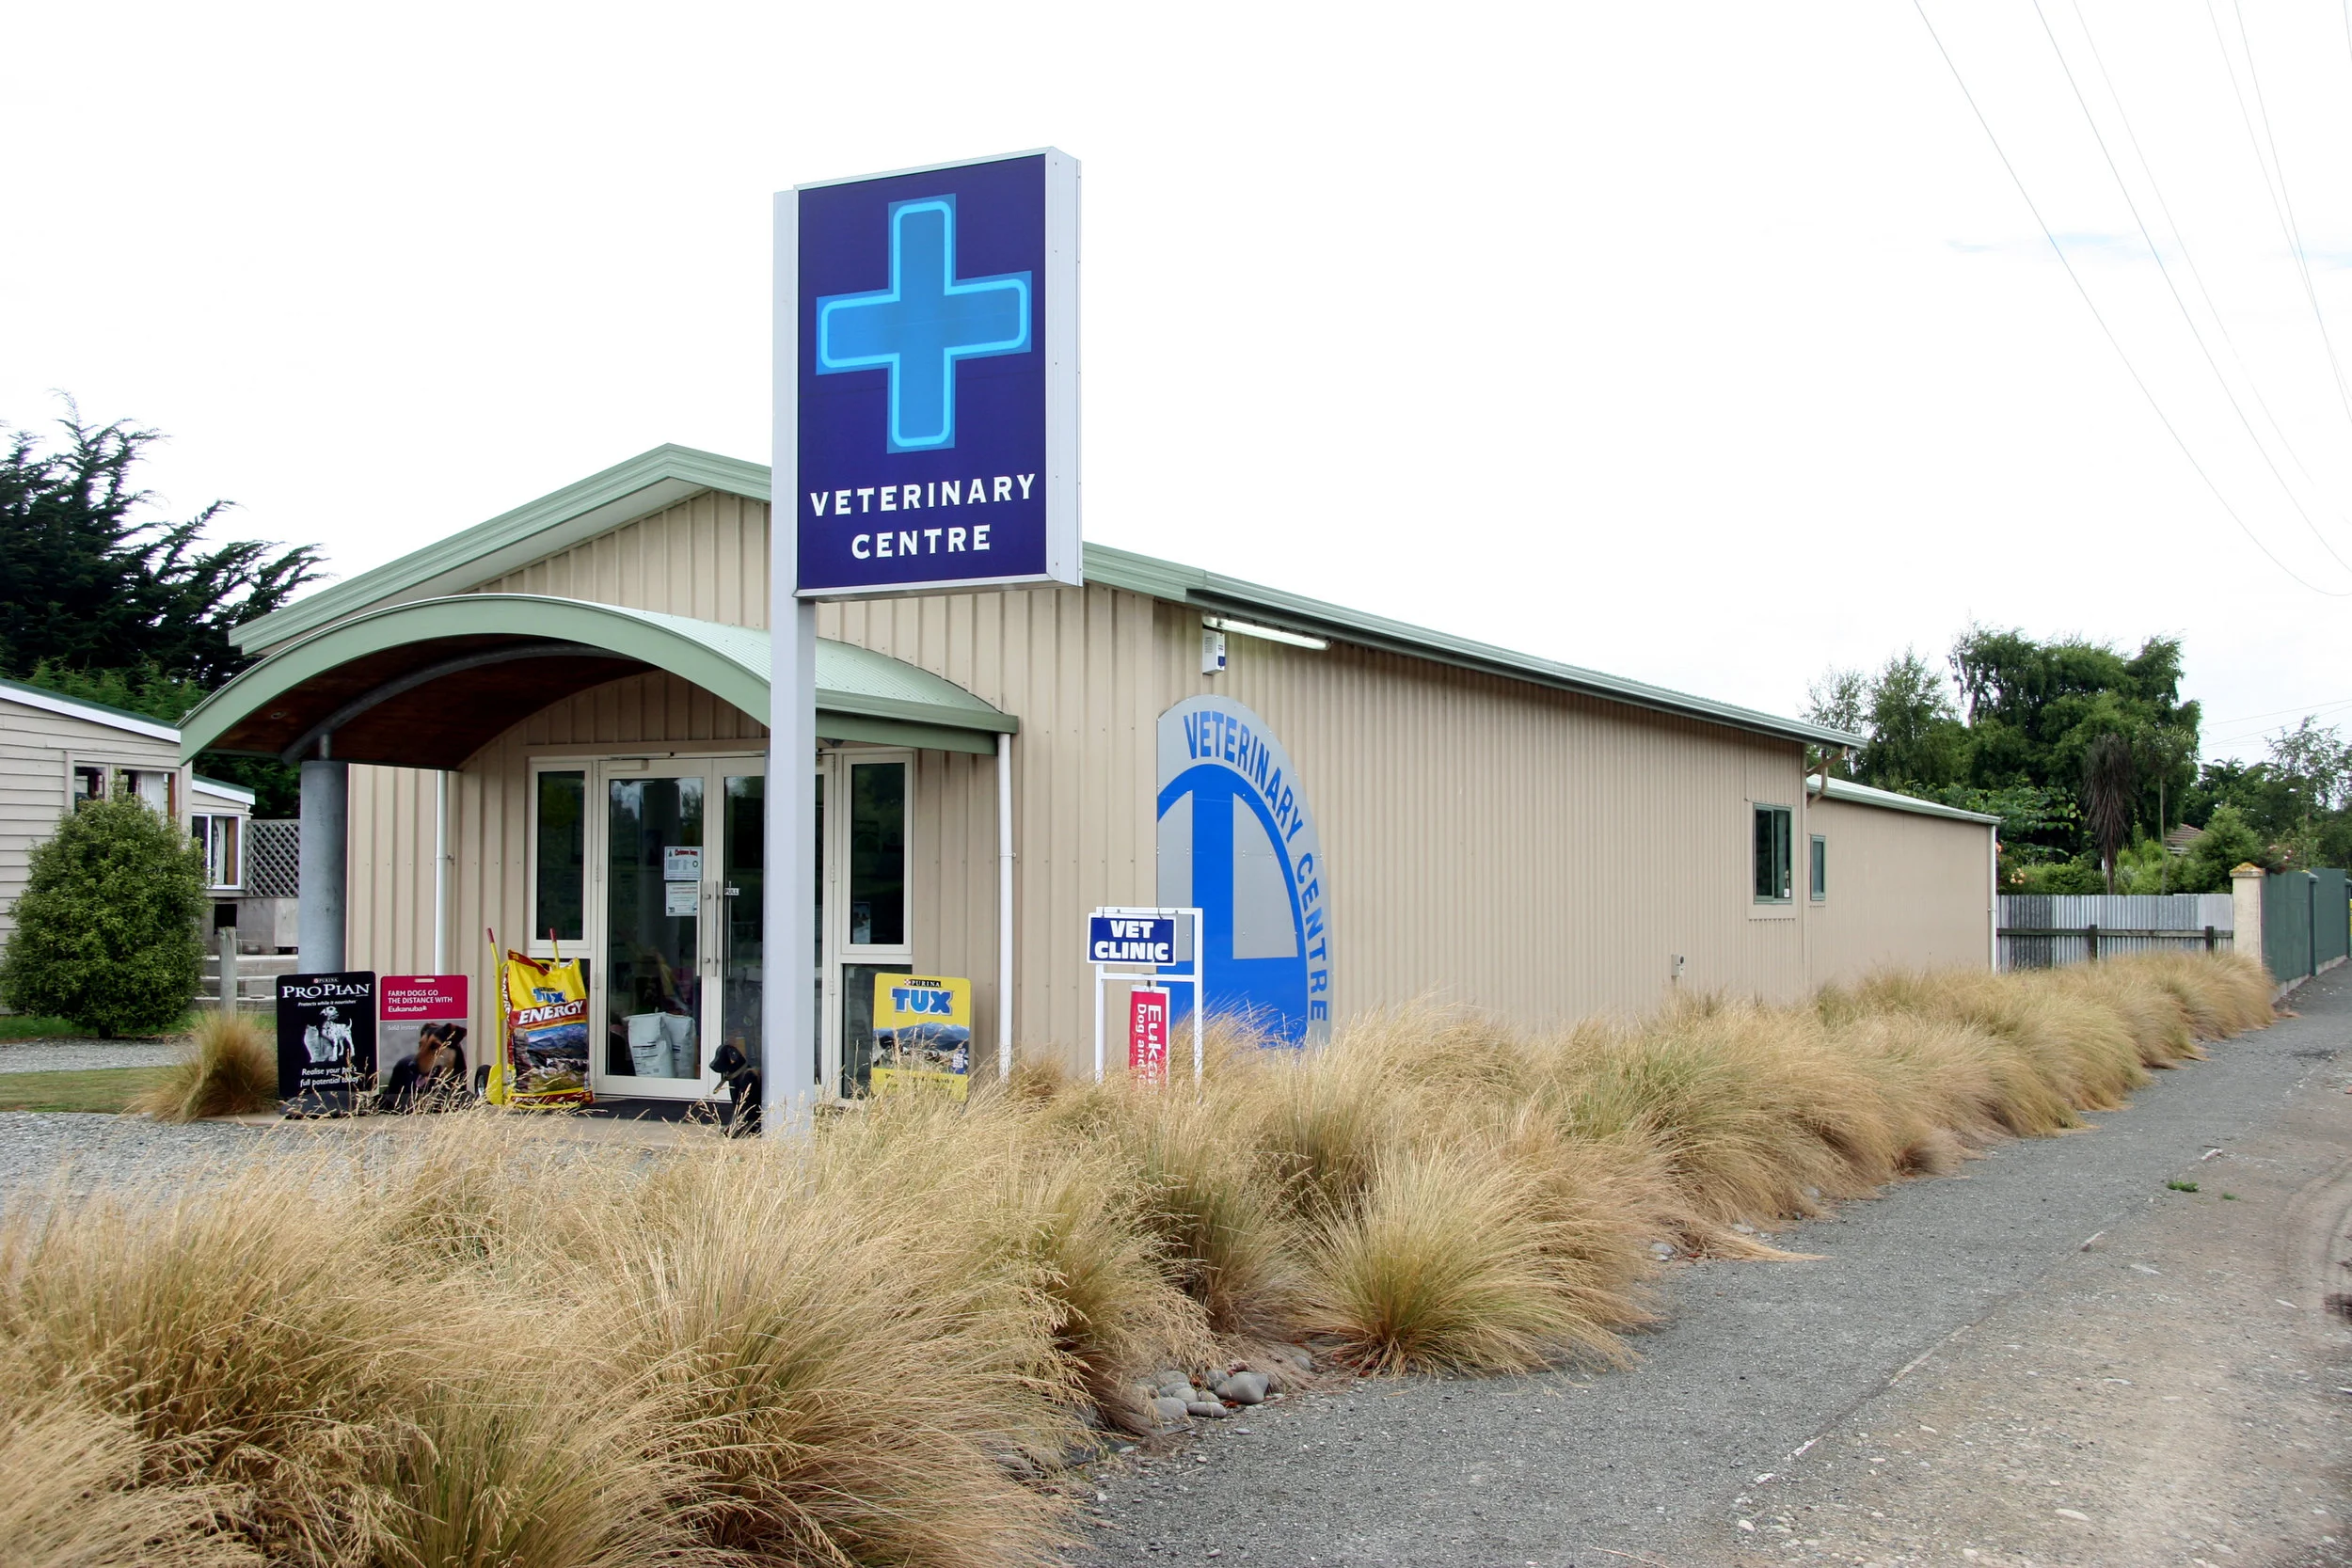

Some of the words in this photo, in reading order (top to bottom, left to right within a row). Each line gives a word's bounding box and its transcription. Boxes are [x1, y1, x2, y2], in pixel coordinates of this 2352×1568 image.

[810, 473, 1036, 516] VETERINARY
[851, 524, 991, 560] CENTRE
[1184, 711, 1304, 844] VETERINARY
[1296, 852, 1327, 1022] CENTRE
[1110, 920, 1154, 939] VET
[1094, 941, 1169, 961] CLINIC
[518, 1000, 583, 1025] ENERGY
[891, 987, 953, 1015] TUX
[1136, 1004, 1147, 1034] Dog
[300, 1079, 310, 1087] full
[312, 1076, 341, 1086] potential
[302, 1068, 325, 1076] Realise
[326, 1068, 340, 1076] your
